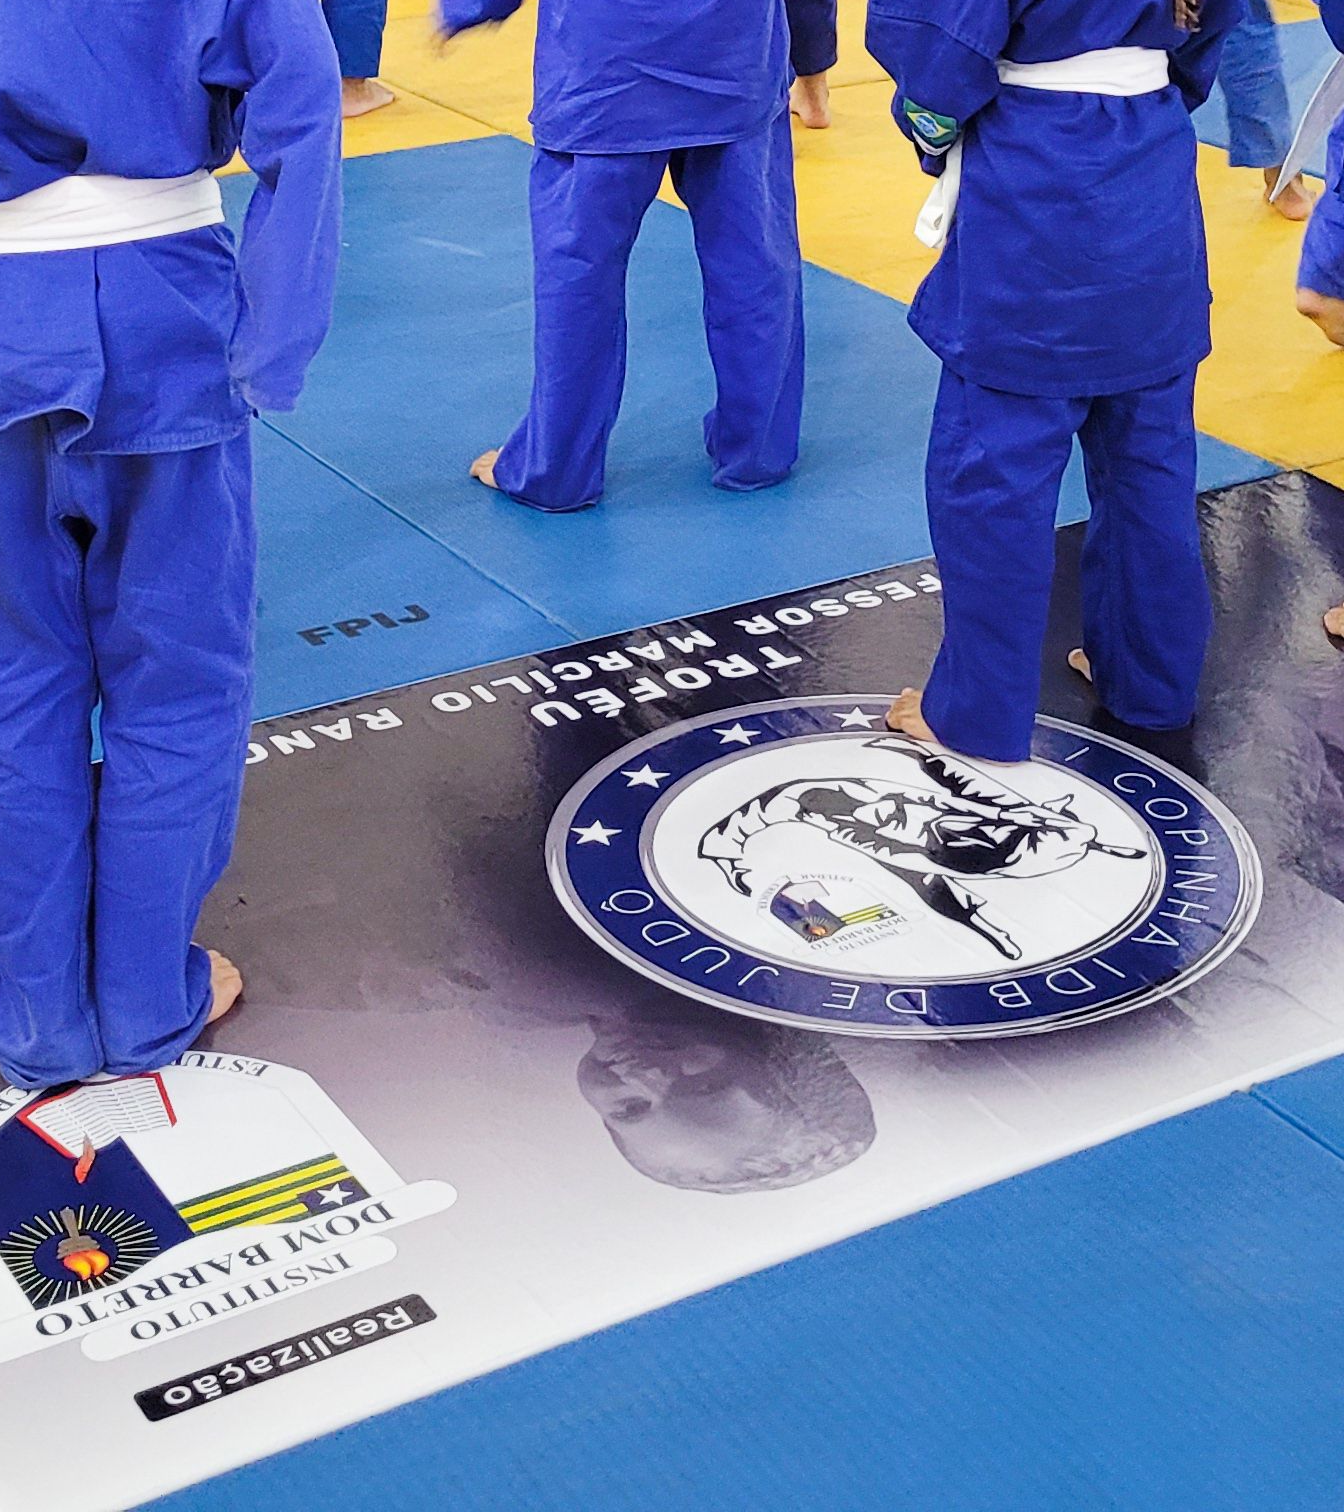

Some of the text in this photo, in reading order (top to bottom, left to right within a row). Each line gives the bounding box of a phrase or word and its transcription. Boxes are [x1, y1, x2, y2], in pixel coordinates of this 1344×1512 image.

[297, 603, 430, 647] FPIJ
[733, 572, 943, 635] FESSOR
[430, 628, 718, 715] MARCÍLIO
[529, 646, 804, 729] TROFÉU
[1112, 771, 1216, 948] COPINHA
[599, 888, 780, 989] JUDÔ
[821, 983, 929, 1016] DE
[989, 957, 1126, 1009] IDB
[172, 1053, 270, 1077] ESTU
[35, 1200, 396, 1338] DOM BARRETO
[129, 1254, 352, 1341] INSTITUTO
[162, 1305, 415, 1404] Realização
